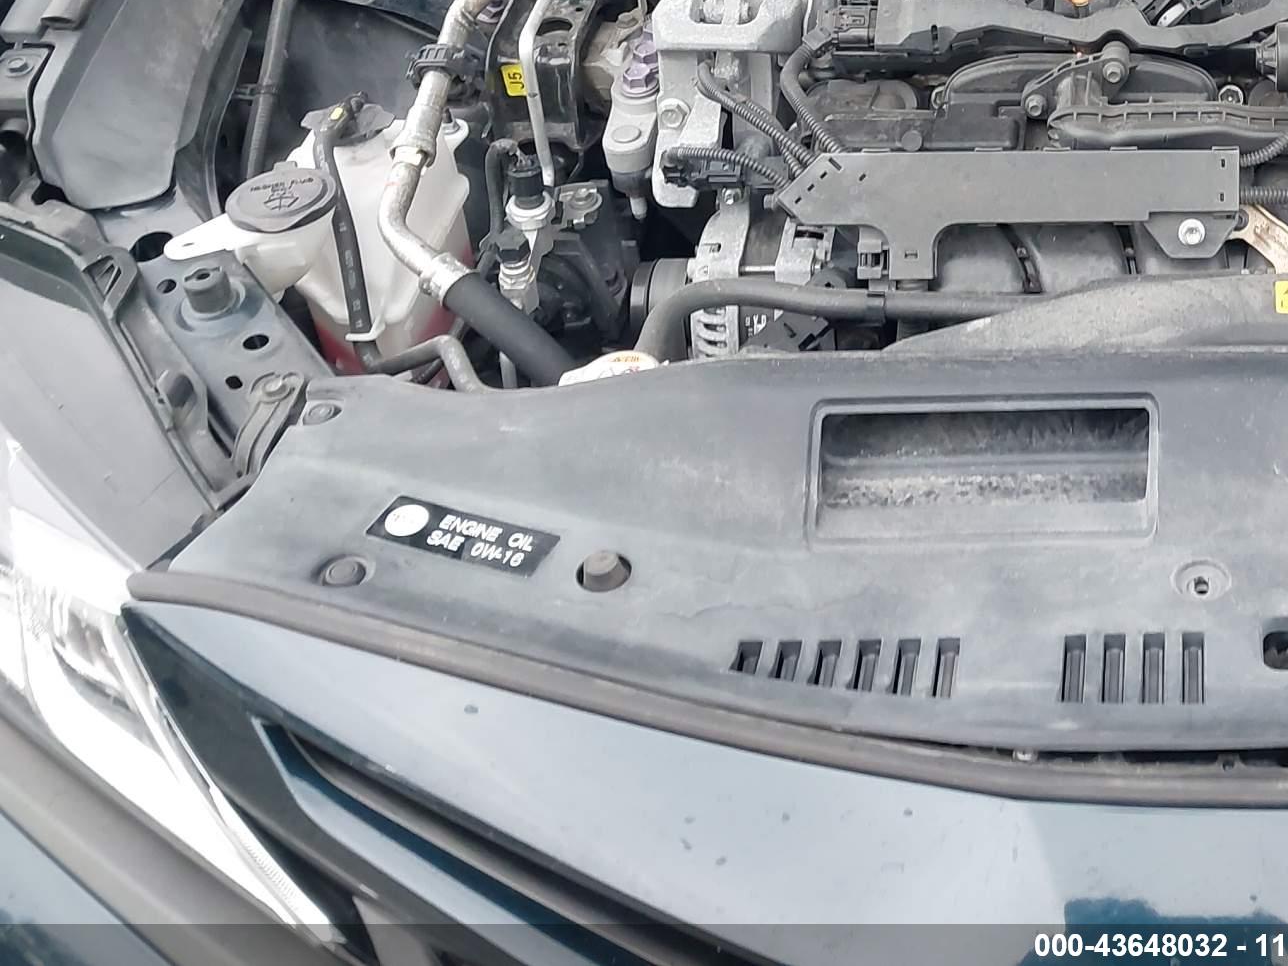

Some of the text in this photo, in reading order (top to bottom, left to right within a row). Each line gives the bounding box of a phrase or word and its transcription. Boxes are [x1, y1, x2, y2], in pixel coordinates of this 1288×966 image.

[507, 72, 525, 90] J5
[426, 530, 465, 552] SAE
[439, 514, 534, 552] ENGINE OIL
